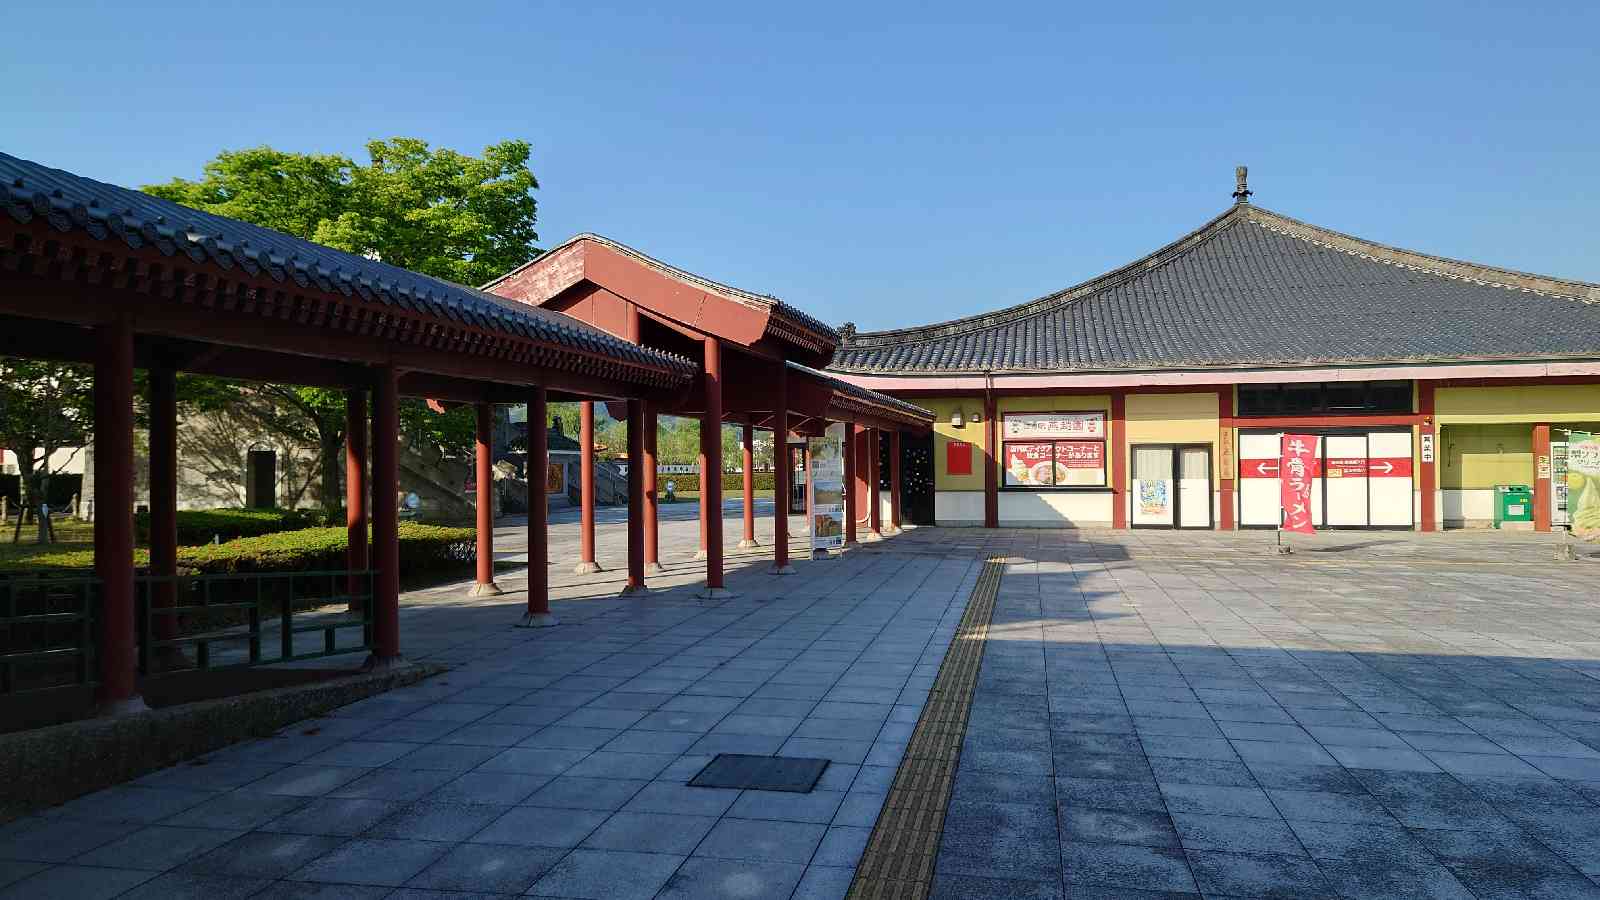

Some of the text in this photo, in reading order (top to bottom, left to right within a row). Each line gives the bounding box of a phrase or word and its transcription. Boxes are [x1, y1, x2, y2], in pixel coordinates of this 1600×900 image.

[1286, 439, 1311, 529] 牛骨ラーメン
